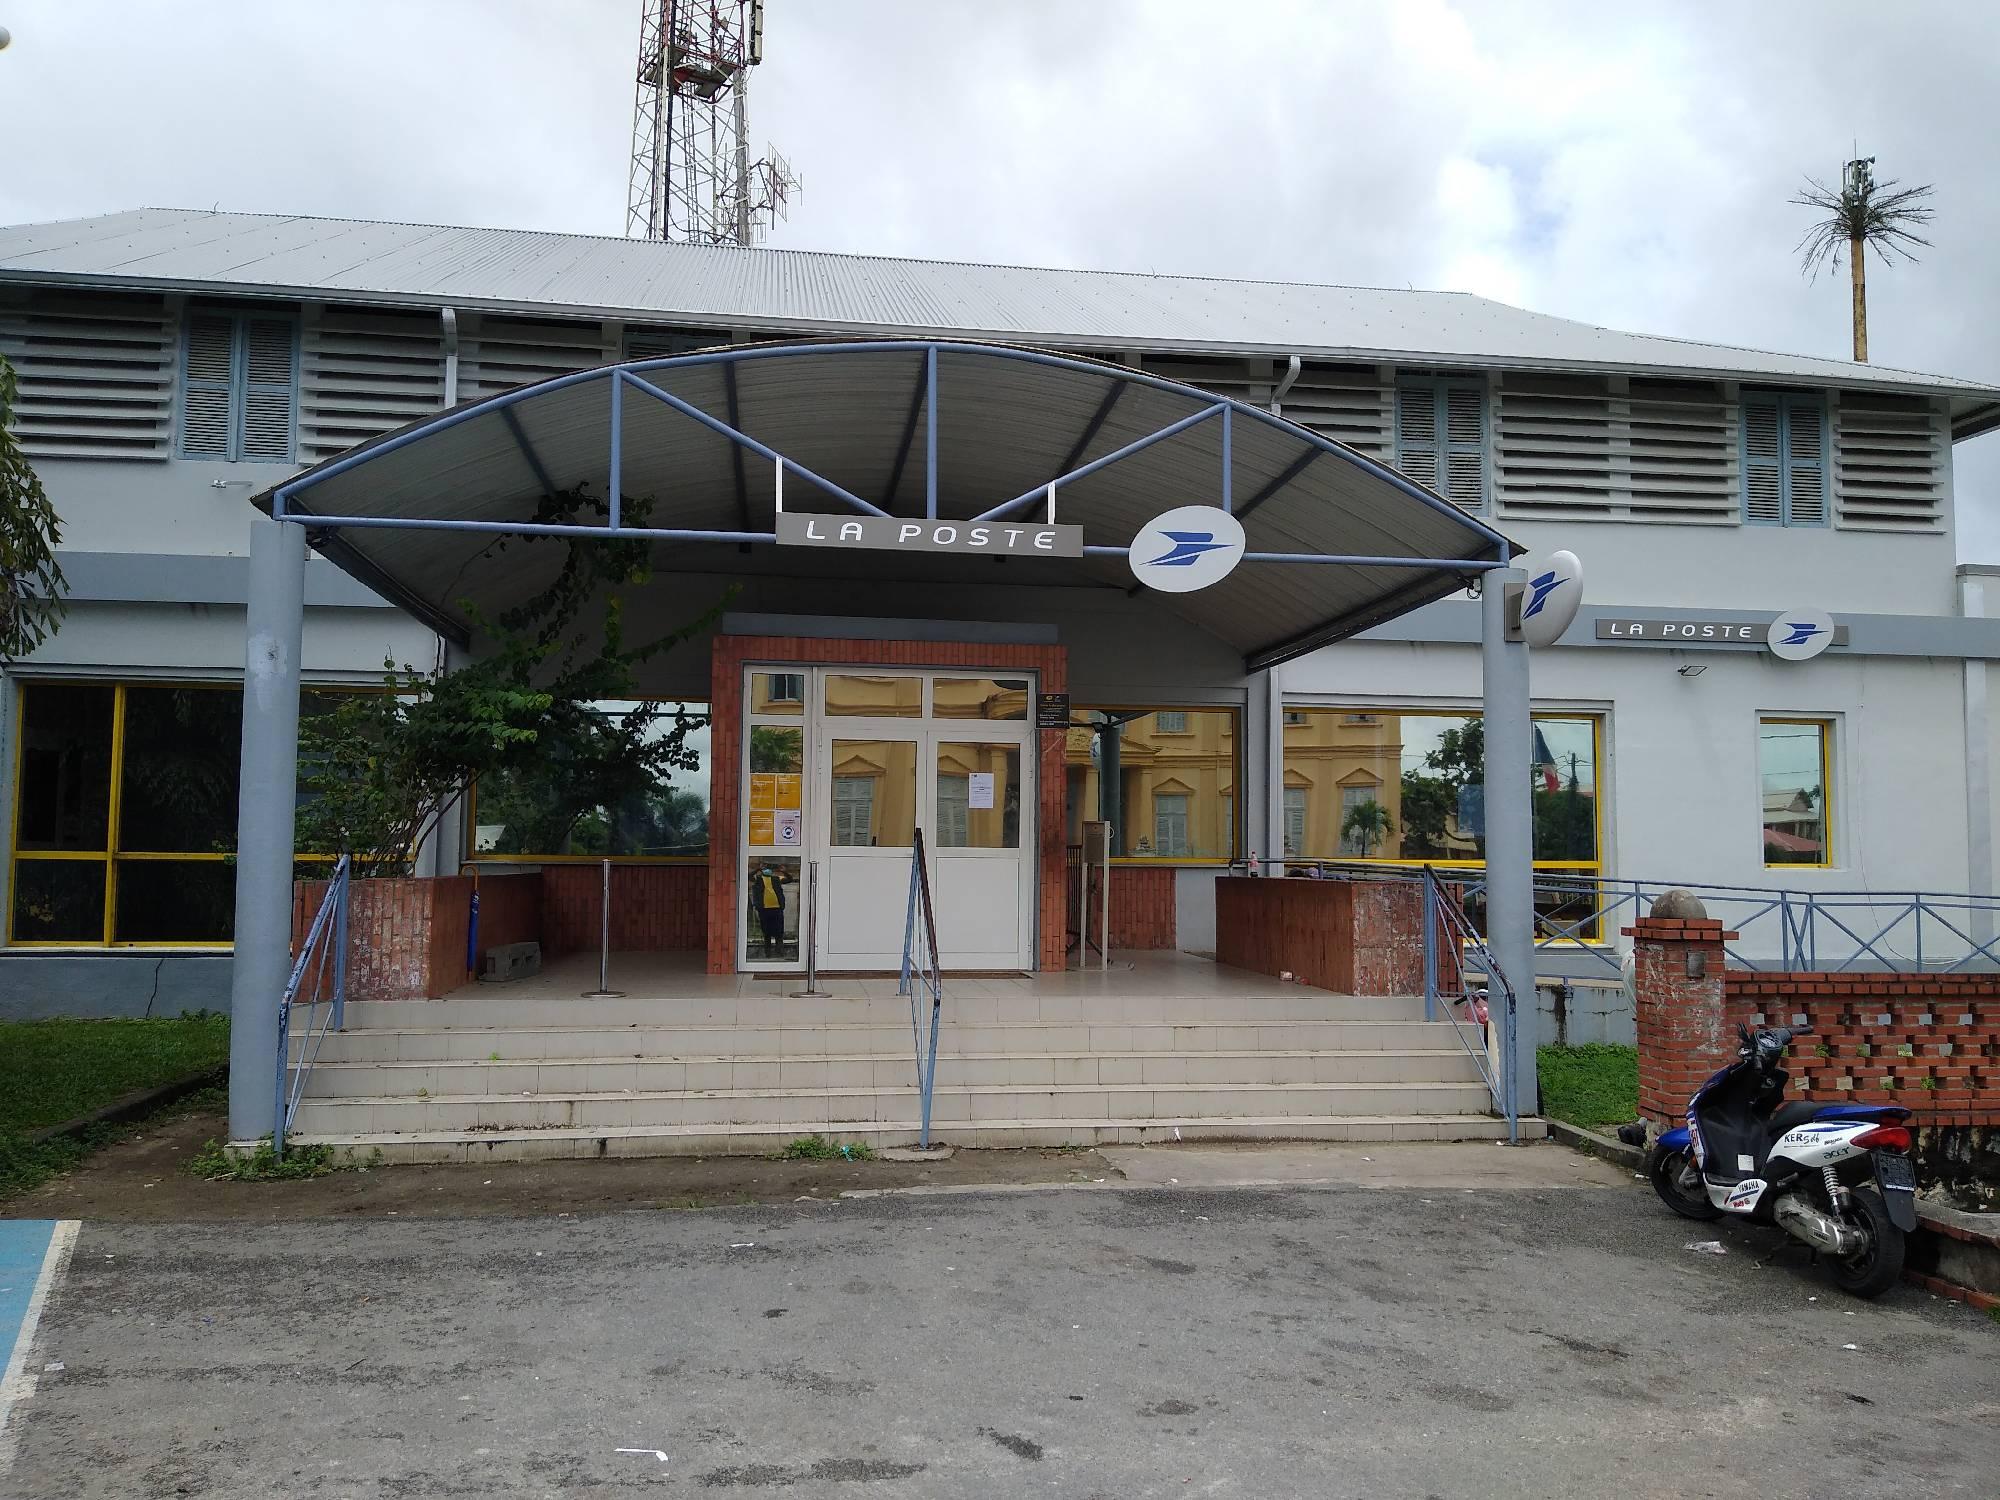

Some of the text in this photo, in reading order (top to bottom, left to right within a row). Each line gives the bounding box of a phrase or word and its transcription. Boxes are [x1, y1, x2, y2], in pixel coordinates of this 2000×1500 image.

[805, 520, 1056, 550] LA POSTE
[1610, 623, 1752, 639] LA POSTE
